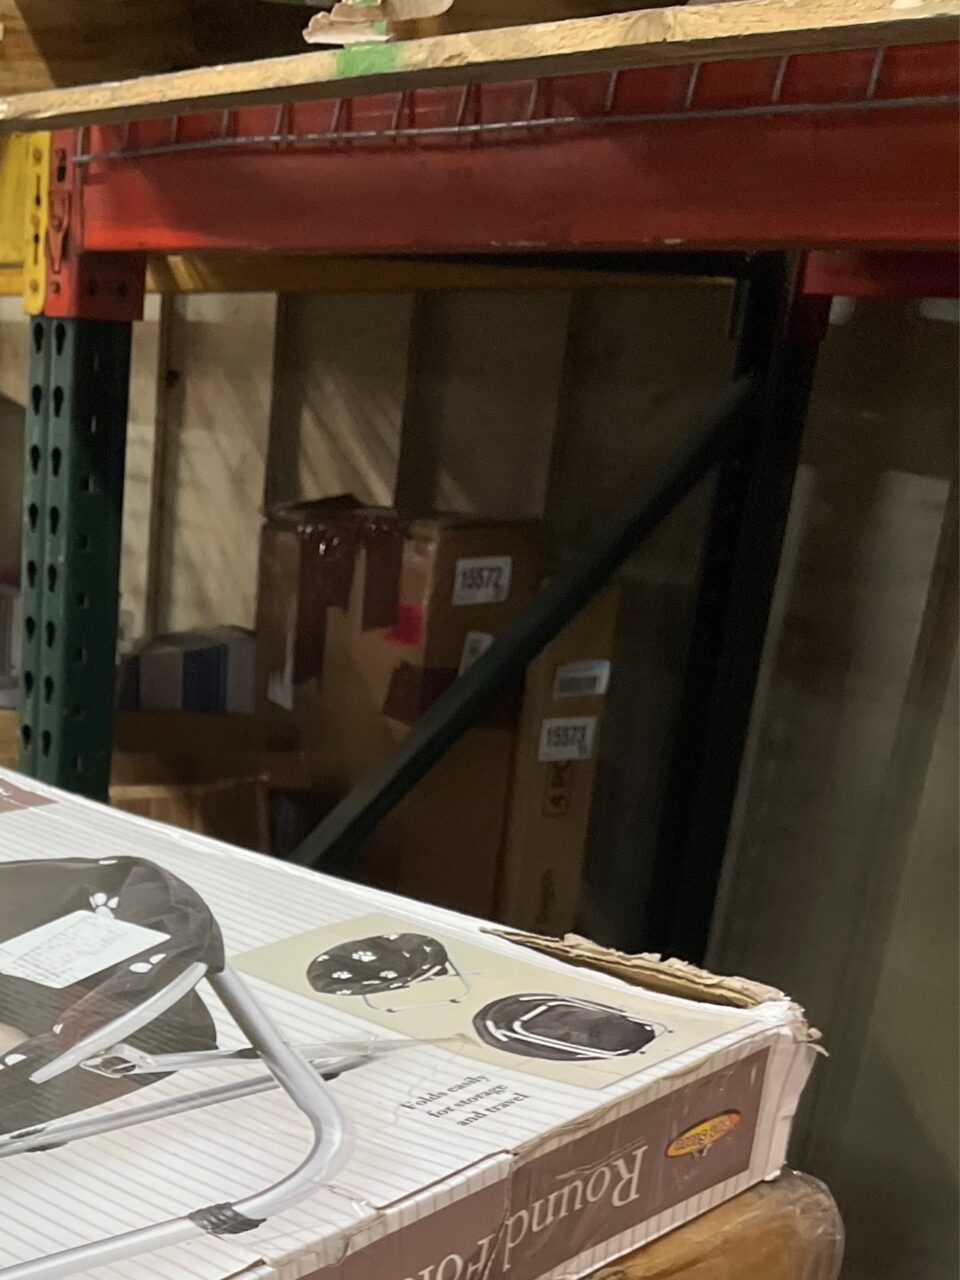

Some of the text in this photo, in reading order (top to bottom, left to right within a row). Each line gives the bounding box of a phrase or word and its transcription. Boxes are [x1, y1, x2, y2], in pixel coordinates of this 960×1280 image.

[400, 1074, 491, 1110] Folds easily
[427, 1083, 509, 1118] for storage
[457, 1092, 530, 1127] and travel
[501, 1146, 649, 1275] Round
